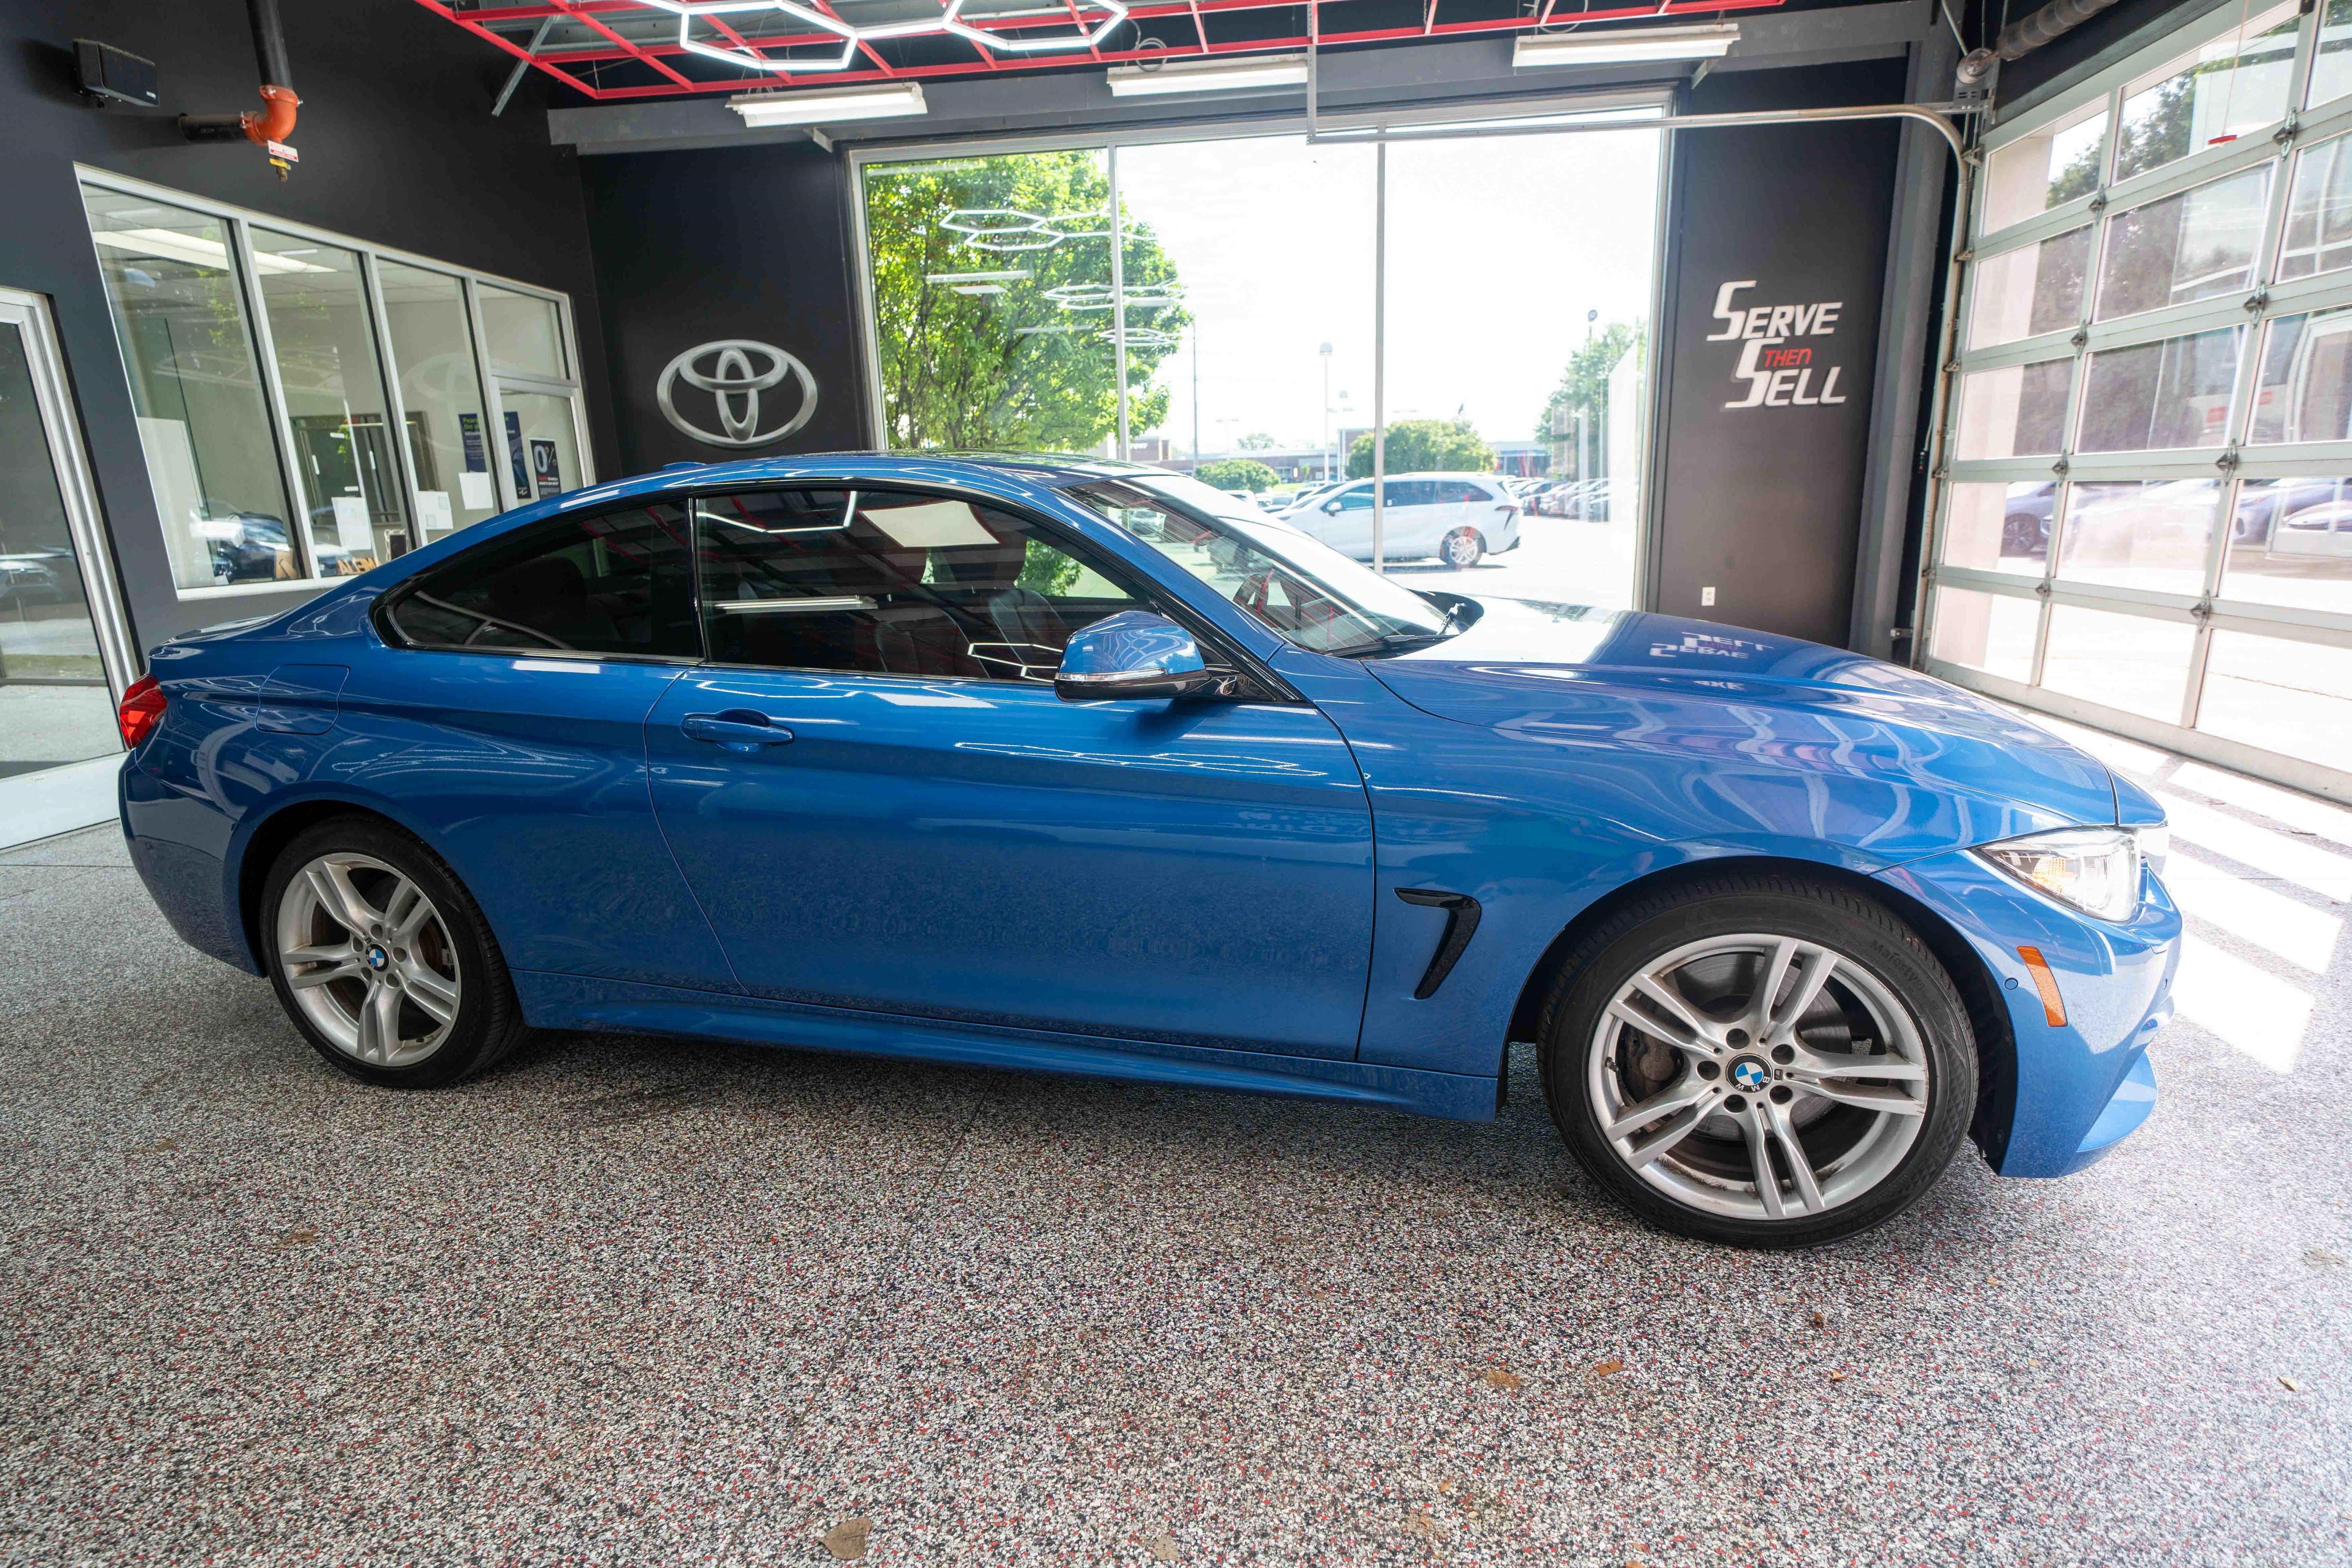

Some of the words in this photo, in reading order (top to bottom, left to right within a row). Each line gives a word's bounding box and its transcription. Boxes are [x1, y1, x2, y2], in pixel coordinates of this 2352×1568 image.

[1706, 280, 1843, 341] SERVE
[1725, 337, 1846, 408] SELL
[1735, 1076, 1771, 1091] BMW
